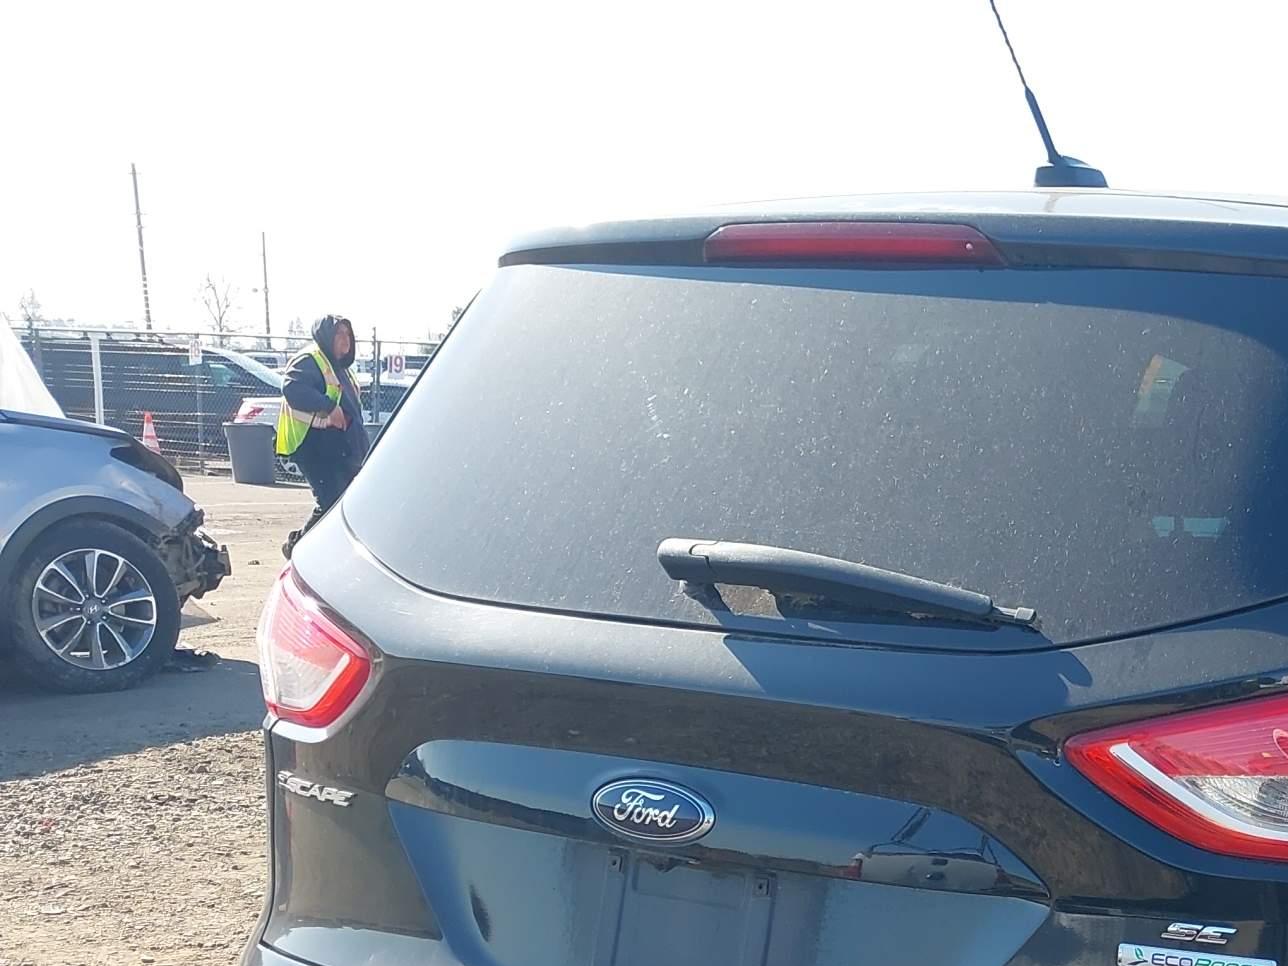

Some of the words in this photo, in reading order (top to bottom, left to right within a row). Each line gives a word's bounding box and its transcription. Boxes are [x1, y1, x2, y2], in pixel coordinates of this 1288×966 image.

[388, 355, 403, 373] 19
[613, 788, 680, 828] Ford
[1160, 922, 1238, 944] SE
